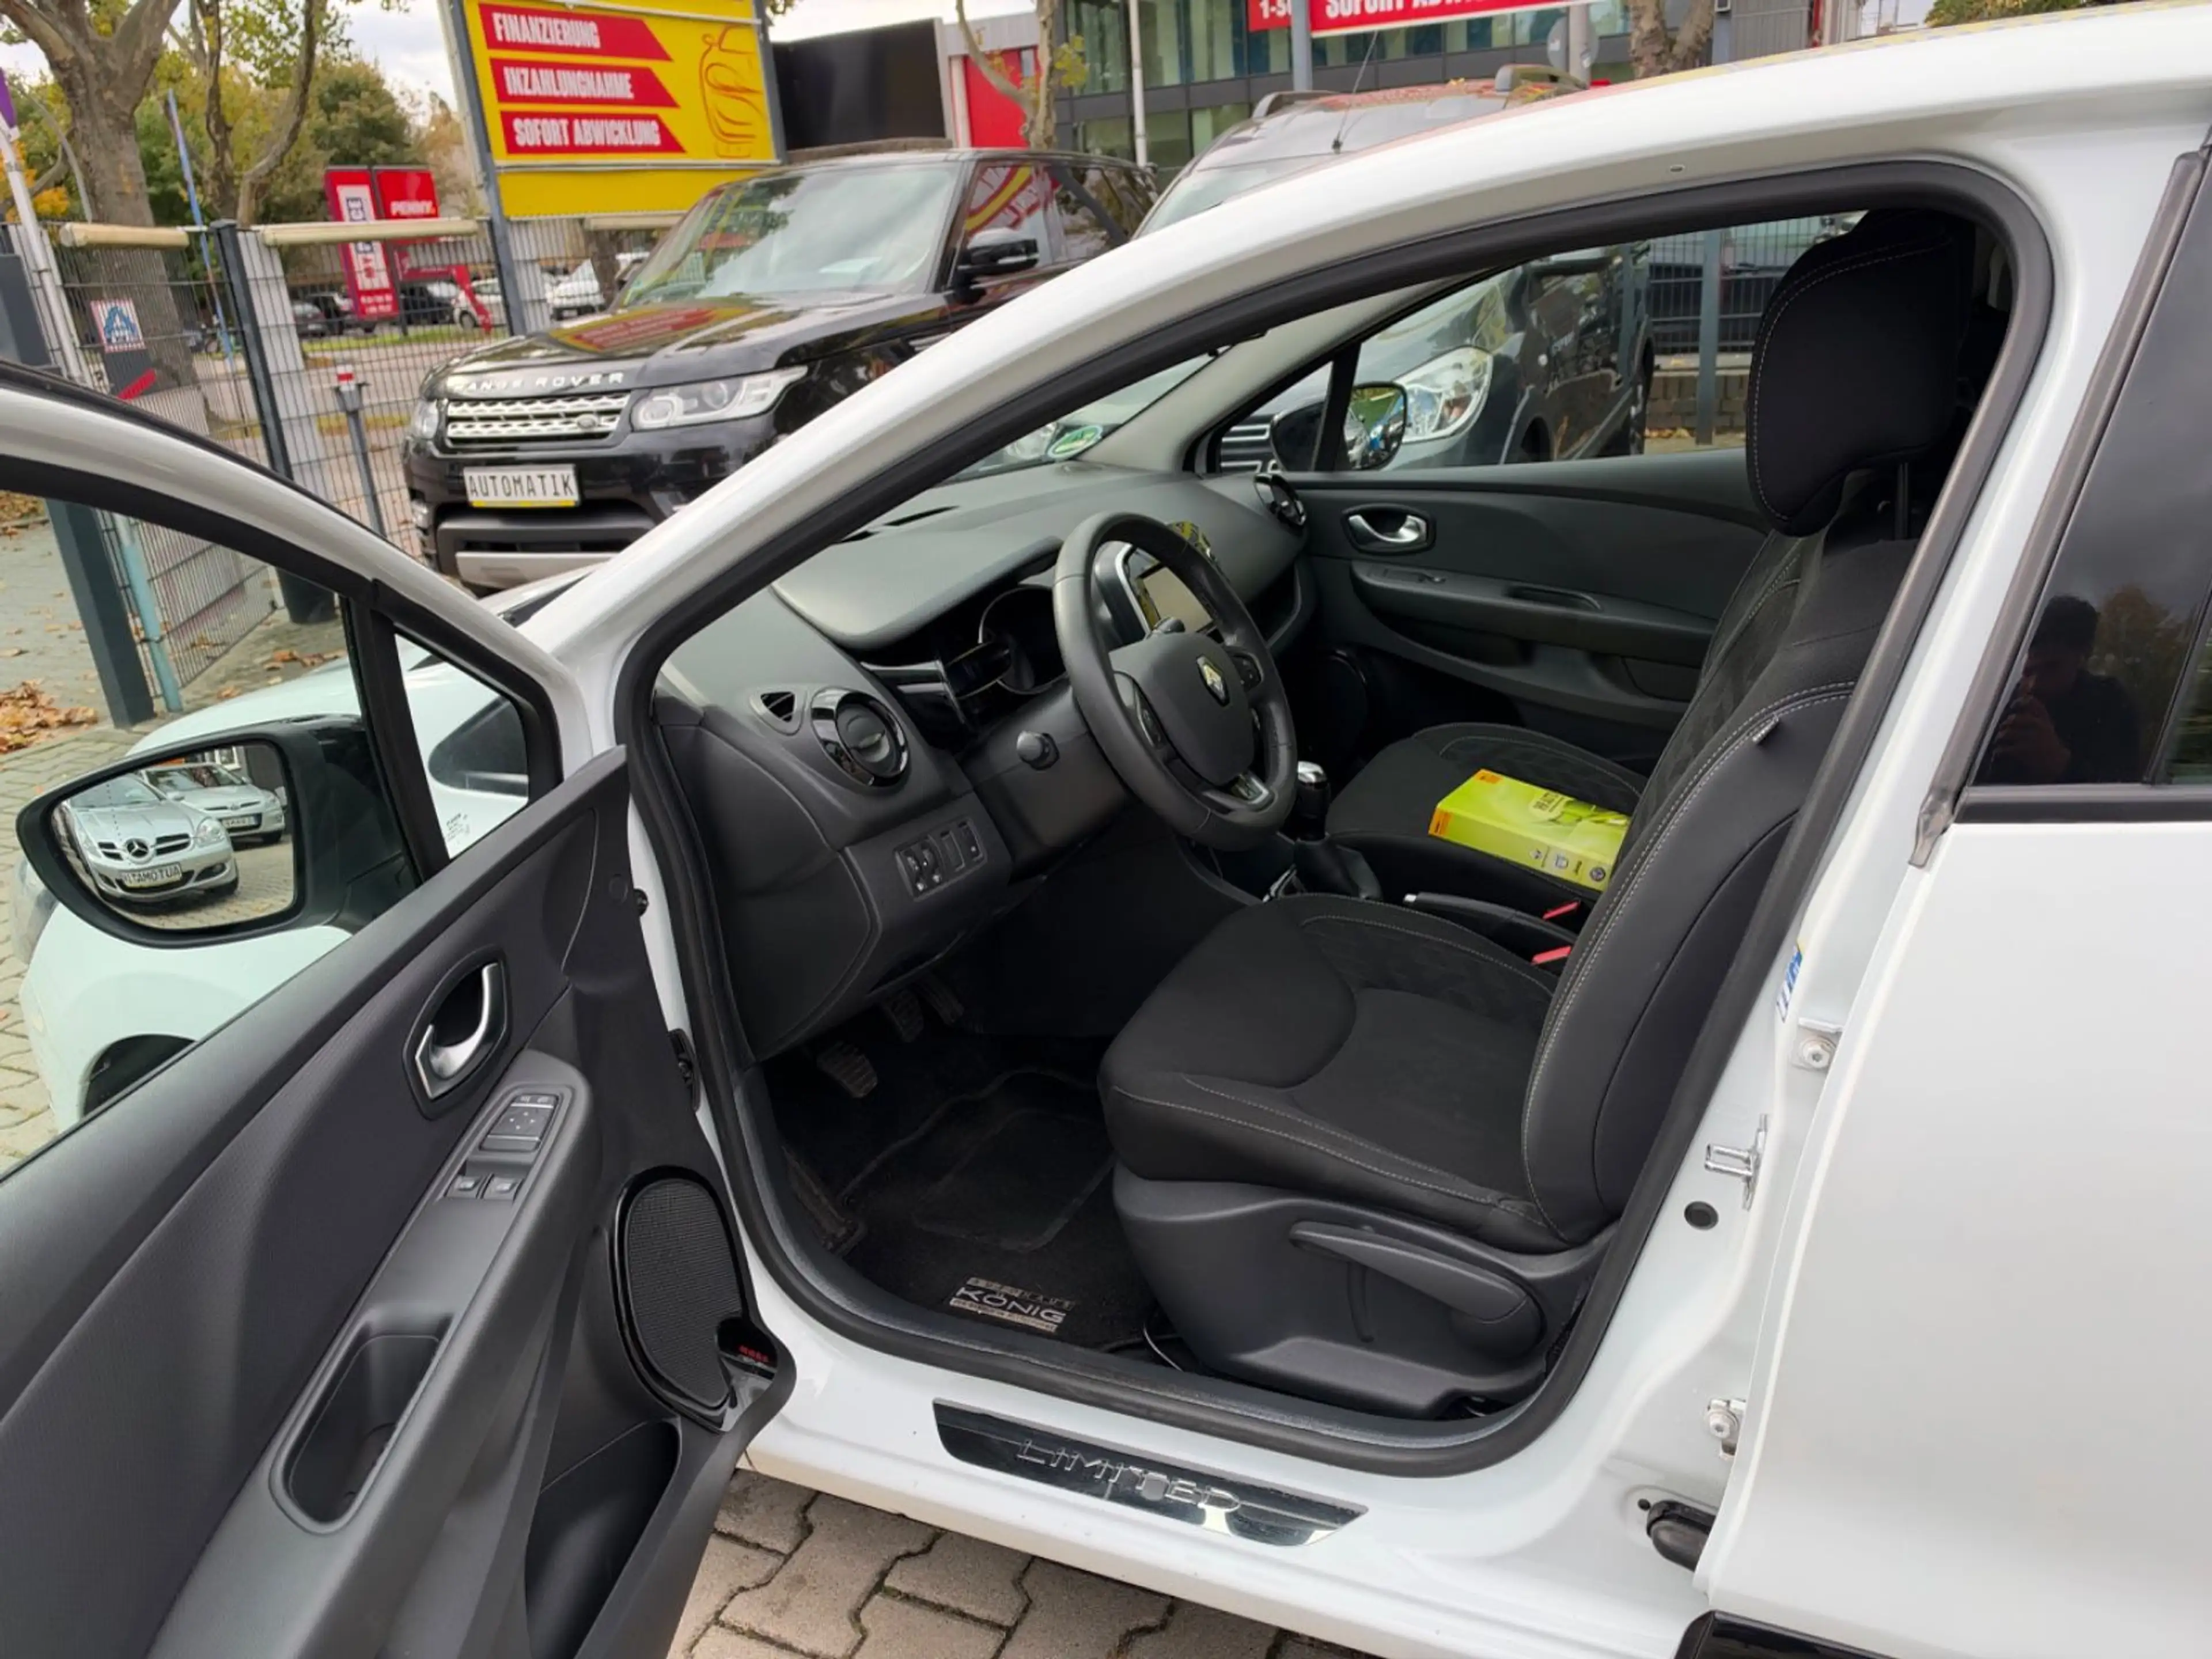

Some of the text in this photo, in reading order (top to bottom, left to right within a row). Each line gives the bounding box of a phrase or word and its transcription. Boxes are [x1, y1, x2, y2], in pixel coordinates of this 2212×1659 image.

[494, 13, 600, 48] FINANZIERUNG
[513, 118, 660, 146] SOFORT ABWICKLUNG
[536, 373, 623, 387] ROVER
[469, 475, 574, 497] AUTOMATIK
[956, 1286, 1066, 1324] KÖNIG
[1017, 1439, 1241, 1513] LIMITED
